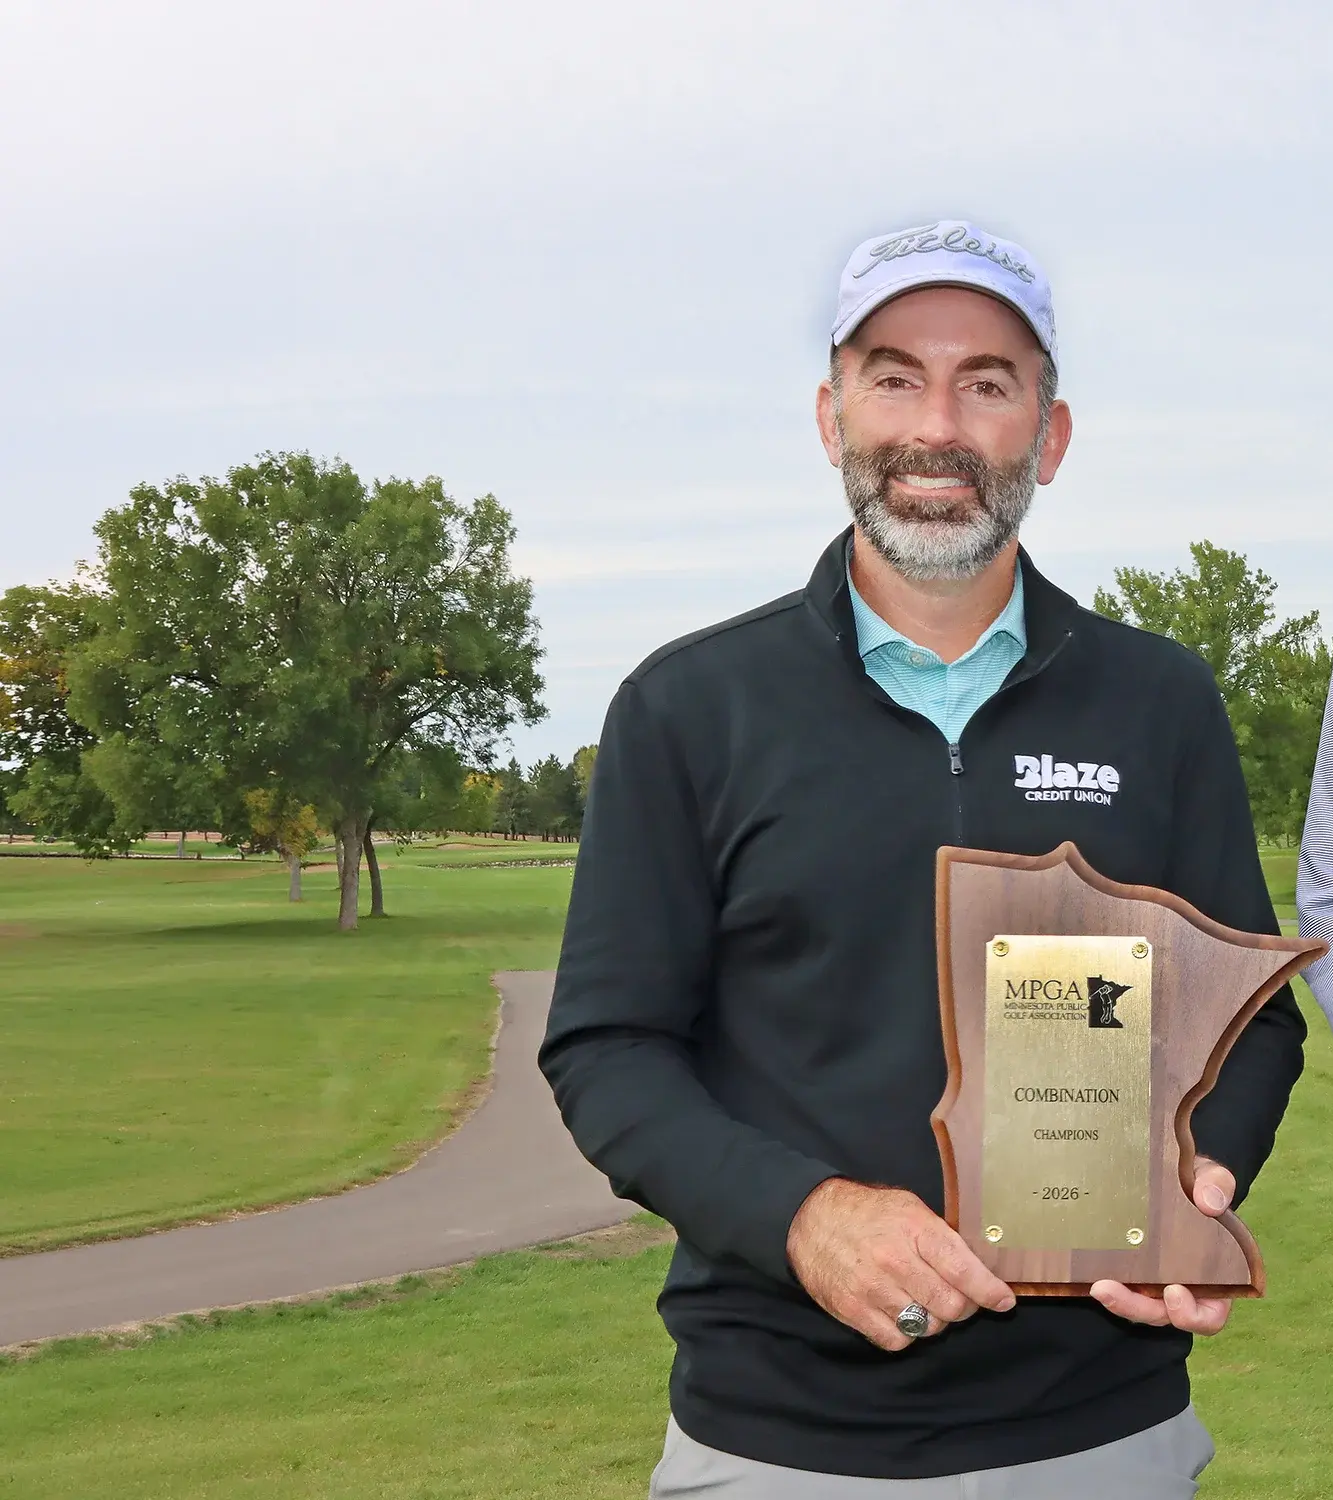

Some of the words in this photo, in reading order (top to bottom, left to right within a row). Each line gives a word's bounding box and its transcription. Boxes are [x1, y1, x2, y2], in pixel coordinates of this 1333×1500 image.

[852, 223, 1036, 284] Titleist
[1014, 754, 1120, 793] Blaze
[1025, 790, 1071, 801] CREDIT
[1074, 790, 1111, 806] UNION
[1005, 980, 1083, 1001] MPGA
[1004, 1003, 1054, 1011] MINNESOTA
[1056, 1003, 1088, 1011] PUBLIC
[1004, 1012, 1027, 1020] GOLF
[1029, 1012, 1087, 1021] ASSOCIATION
[1014, 1087, 1120, 1103] COMBINATION
[1033, 1129, 1099, 1141] CHAMPIONS
[1042, 1187, 1079, 1200] 2026
